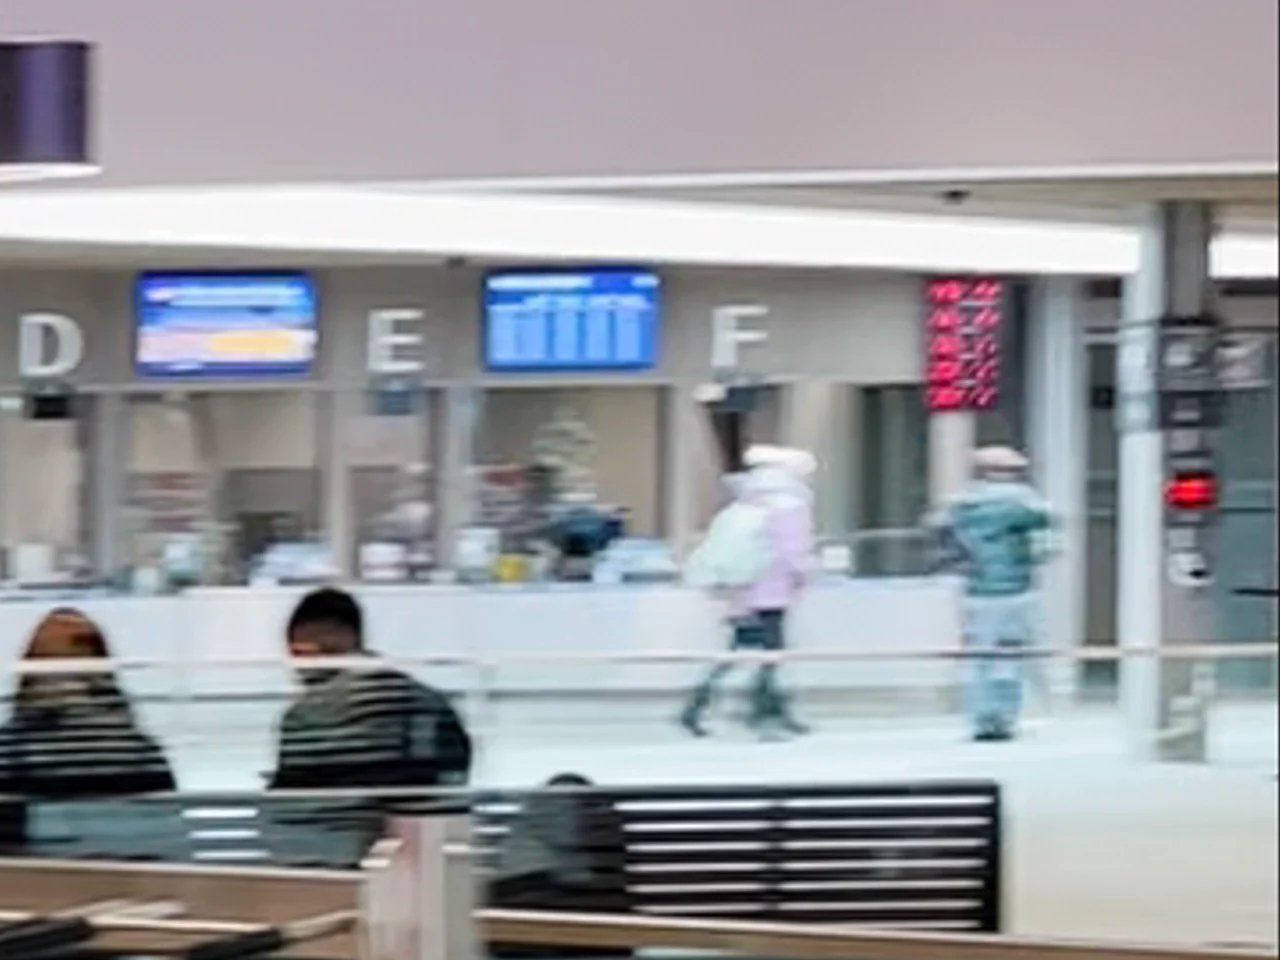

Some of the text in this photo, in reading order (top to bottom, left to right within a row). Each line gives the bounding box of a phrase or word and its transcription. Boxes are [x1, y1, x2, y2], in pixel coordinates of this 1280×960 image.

[18, 312, 85, 377] D
[367, 308, 426, 372] E
[711, 305, 770, 367] F
